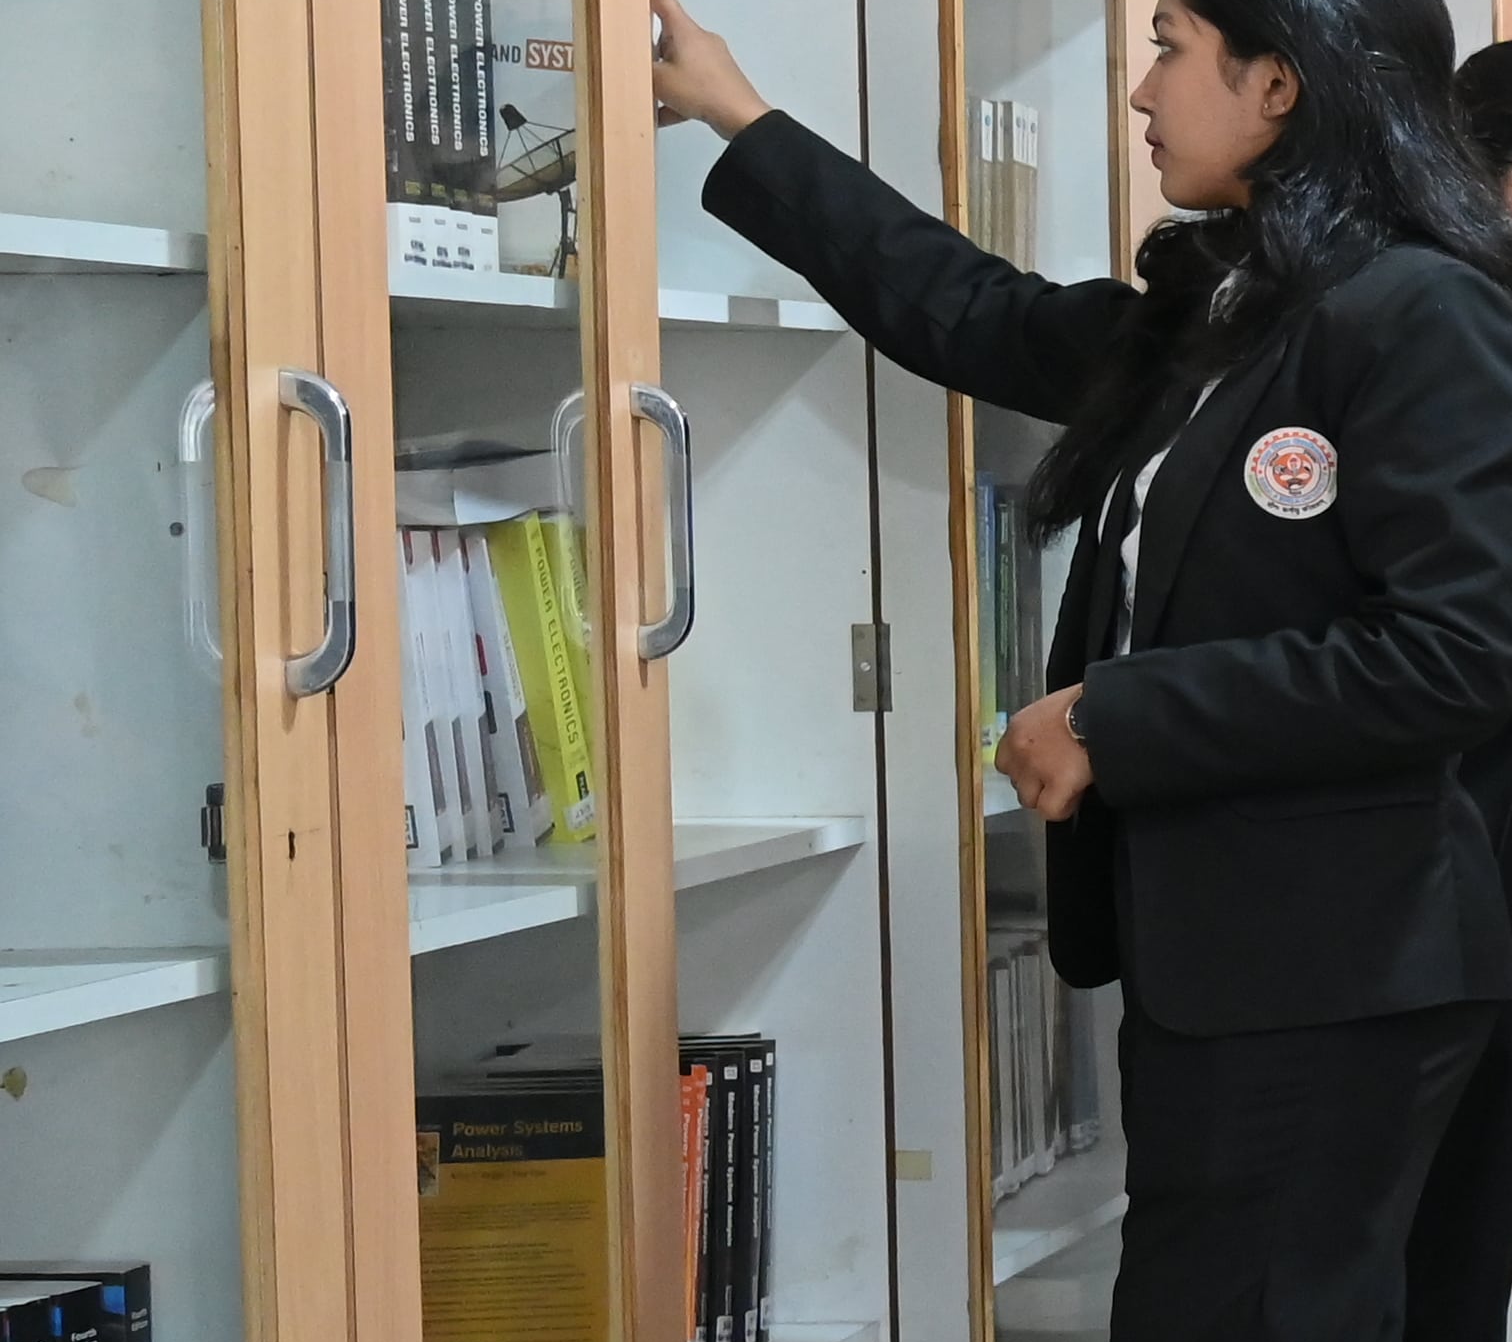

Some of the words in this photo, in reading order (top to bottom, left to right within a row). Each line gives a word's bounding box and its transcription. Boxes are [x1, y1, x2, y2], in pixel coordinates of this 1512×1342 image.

[400, 32, 415, 143] ELECTRONICS
[425, 36, 440, 146] ELECTRONICS
[450, 42, 463, 152] ELECTRONICS
[476, 39, 489, 158] ELECTRONICS
[534, 545, 553, 614] POWER
[548, 617, 580, 747] ELECTRONICS
[451, 1141, 524, 1160] Analysis
[453, 1120, 507, 1138] Power
[513, 1117, 584, 1137] Systems
